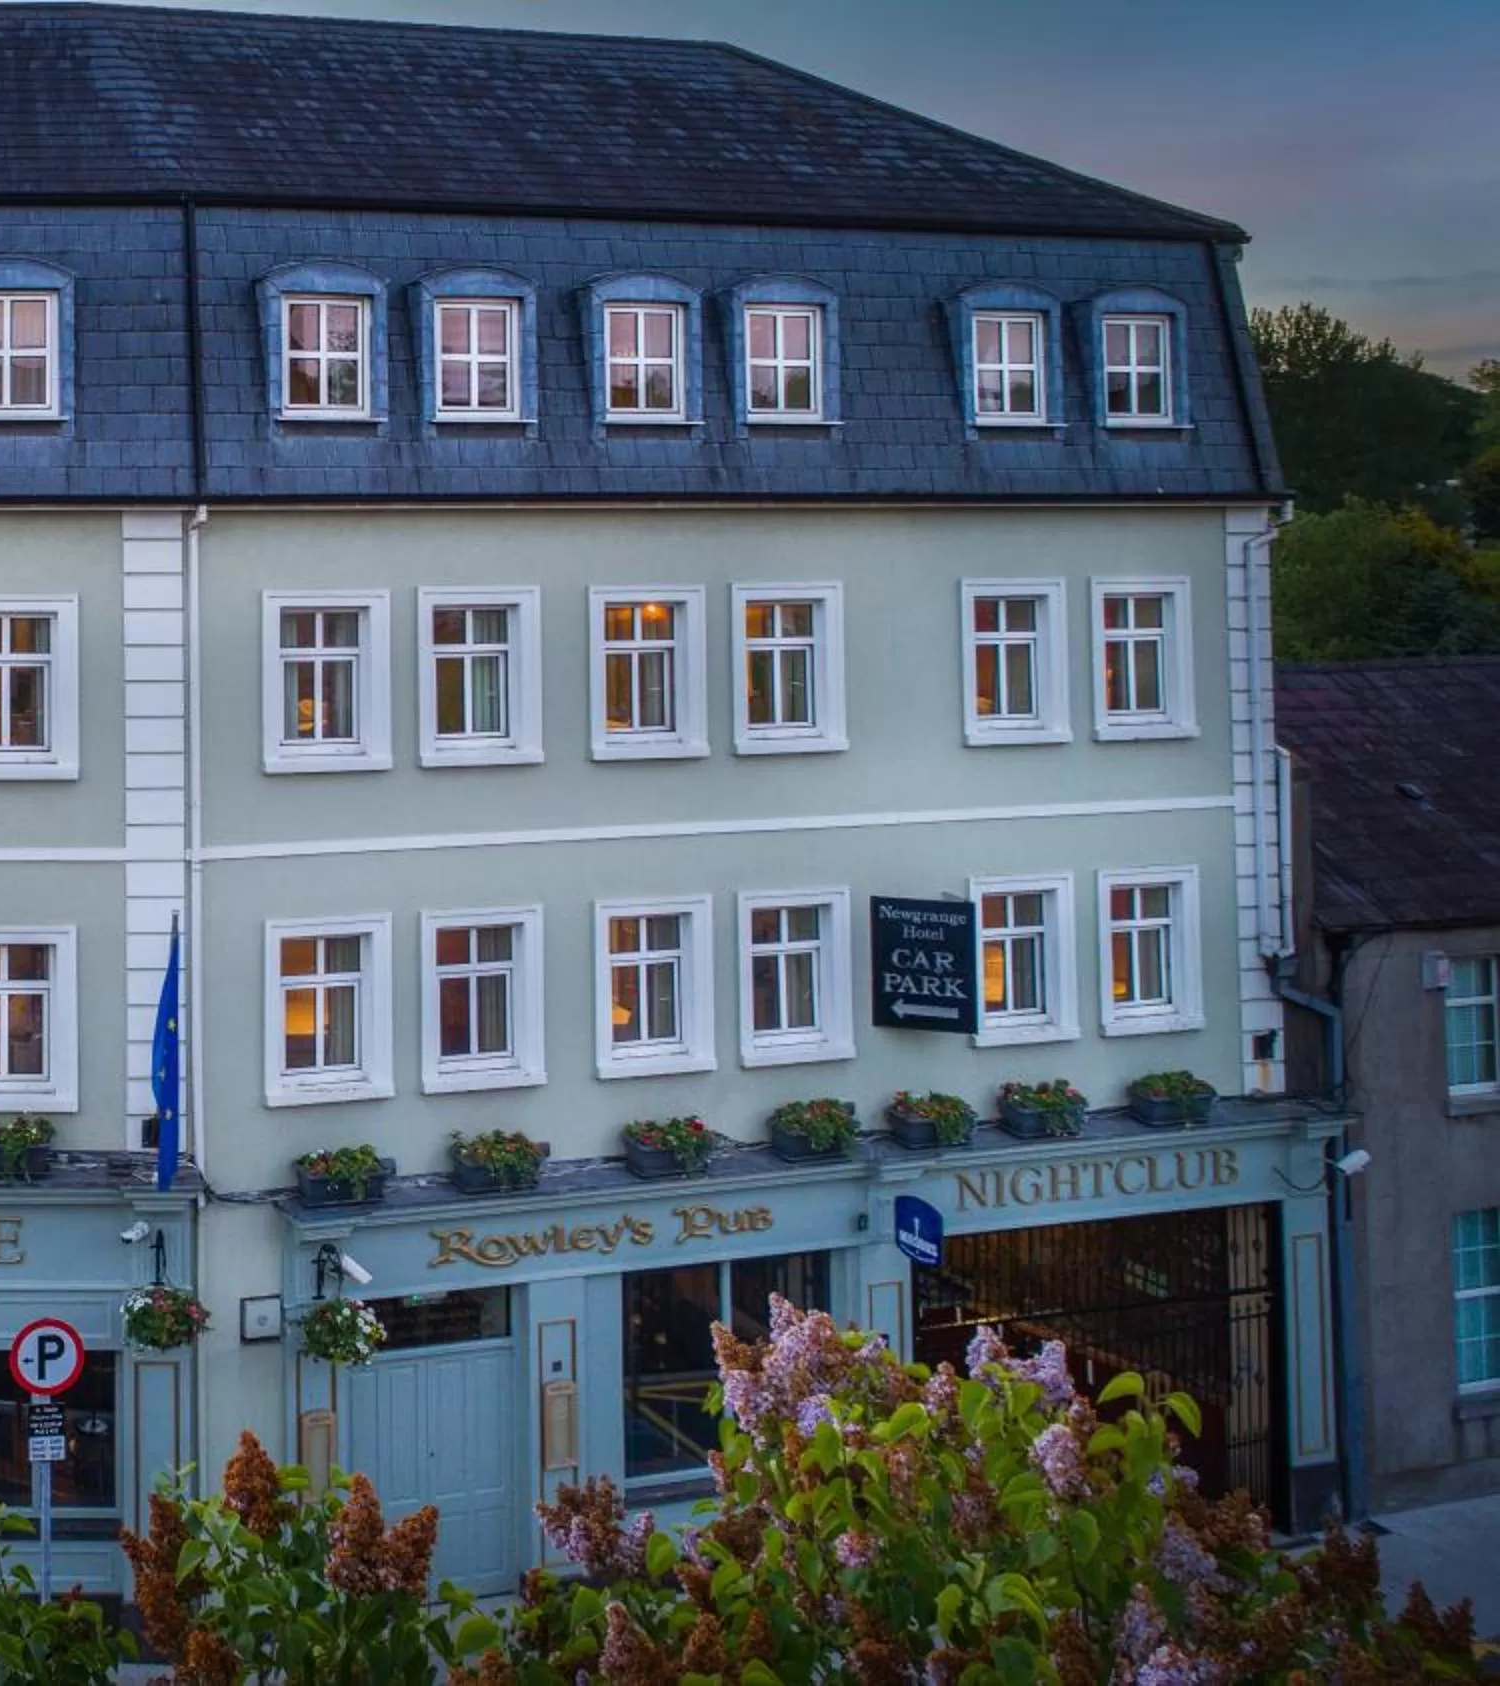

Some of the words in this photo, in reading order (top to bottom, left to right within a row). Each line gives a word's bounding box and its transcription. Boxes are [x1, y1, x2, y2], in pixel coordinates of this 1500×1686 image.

[879, 904, 968, 926] Newgrange
[903, 924, 945, 940] Hotel
[891, 948, 956, 973] CAR
[884, 973, 968, 999] PARK
[955, 1147, 1239, 1212] NIGHTCLUB
[428, 1213, 654, 1269] Rowley's
[37, 1334, 65, 1380] P
